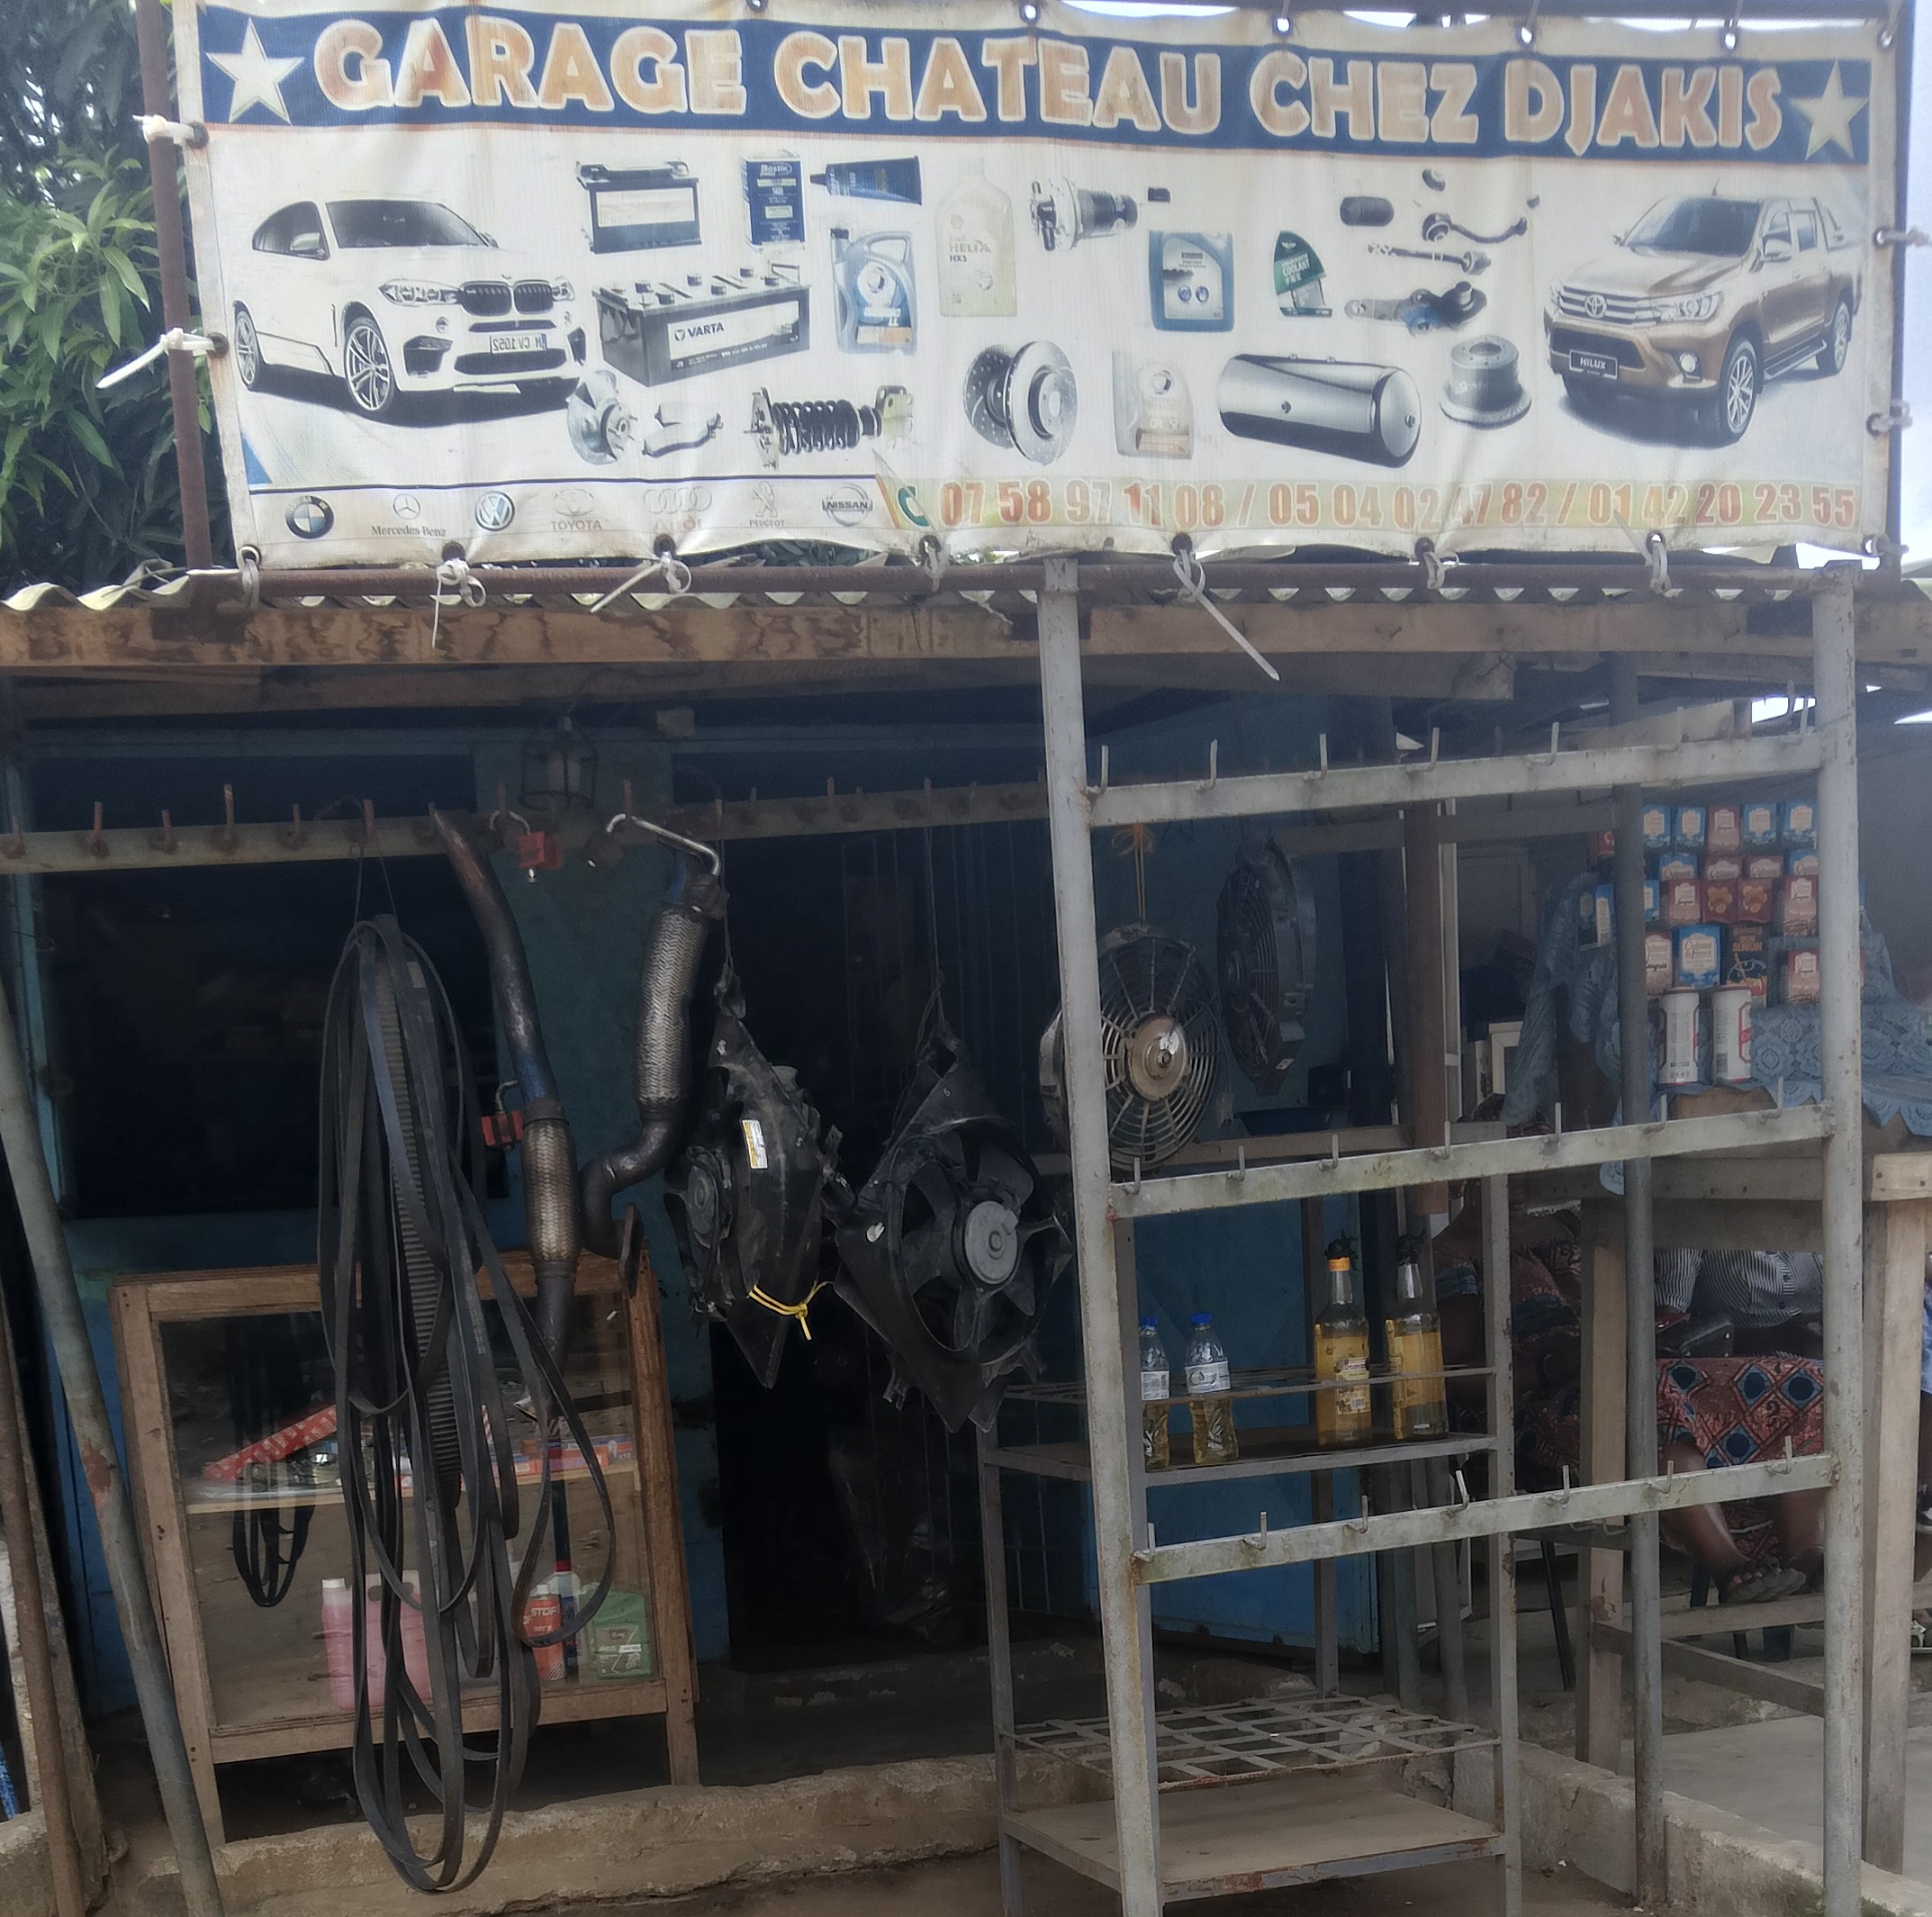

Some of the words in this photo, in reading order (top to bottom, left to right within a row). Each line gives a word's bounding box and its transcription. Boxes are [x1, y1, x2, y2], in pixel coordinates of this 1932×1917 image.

[313, 16, 746, 115] GARAGE
[774, 31, 1222, 134] CHATEAU
[1250, 51, 1478, 143] CHEZ
[1504, 59, 1783, 158] DJAKIS
[687, 322, 725, 338] VARTA
[1580, 357, 1607, 369] HILUX
[826, 501, 869, 511] NISSAN
[940, 480, 986, 528] 07
[998, 480, 1052, 524] 58
[1066, 479, 1112, 523] 97
[1123, 482, 1162, 527] 11
[1175, 483, 1225, 529] 08
[1268, 483, 1321, 526] 05
[1332, 483, 1383, 528] 04
[1394, 484, 1441, 529] 02
[1501, 482, 1548, 525] 82
[1589, 483, 1632, 525] 01
[1642, 482, 1686, 528] 42
[1695, 483, 1742, 525] 20
[1755, 482, 1802, 523] 23
[1812, 486, 1856, 529] 55
[551, 520, 603, 530] TOYOTA
[749, 520, 785, 528] PEUGEOT
[371, 525, 447, 538] Mercedes-Benz
